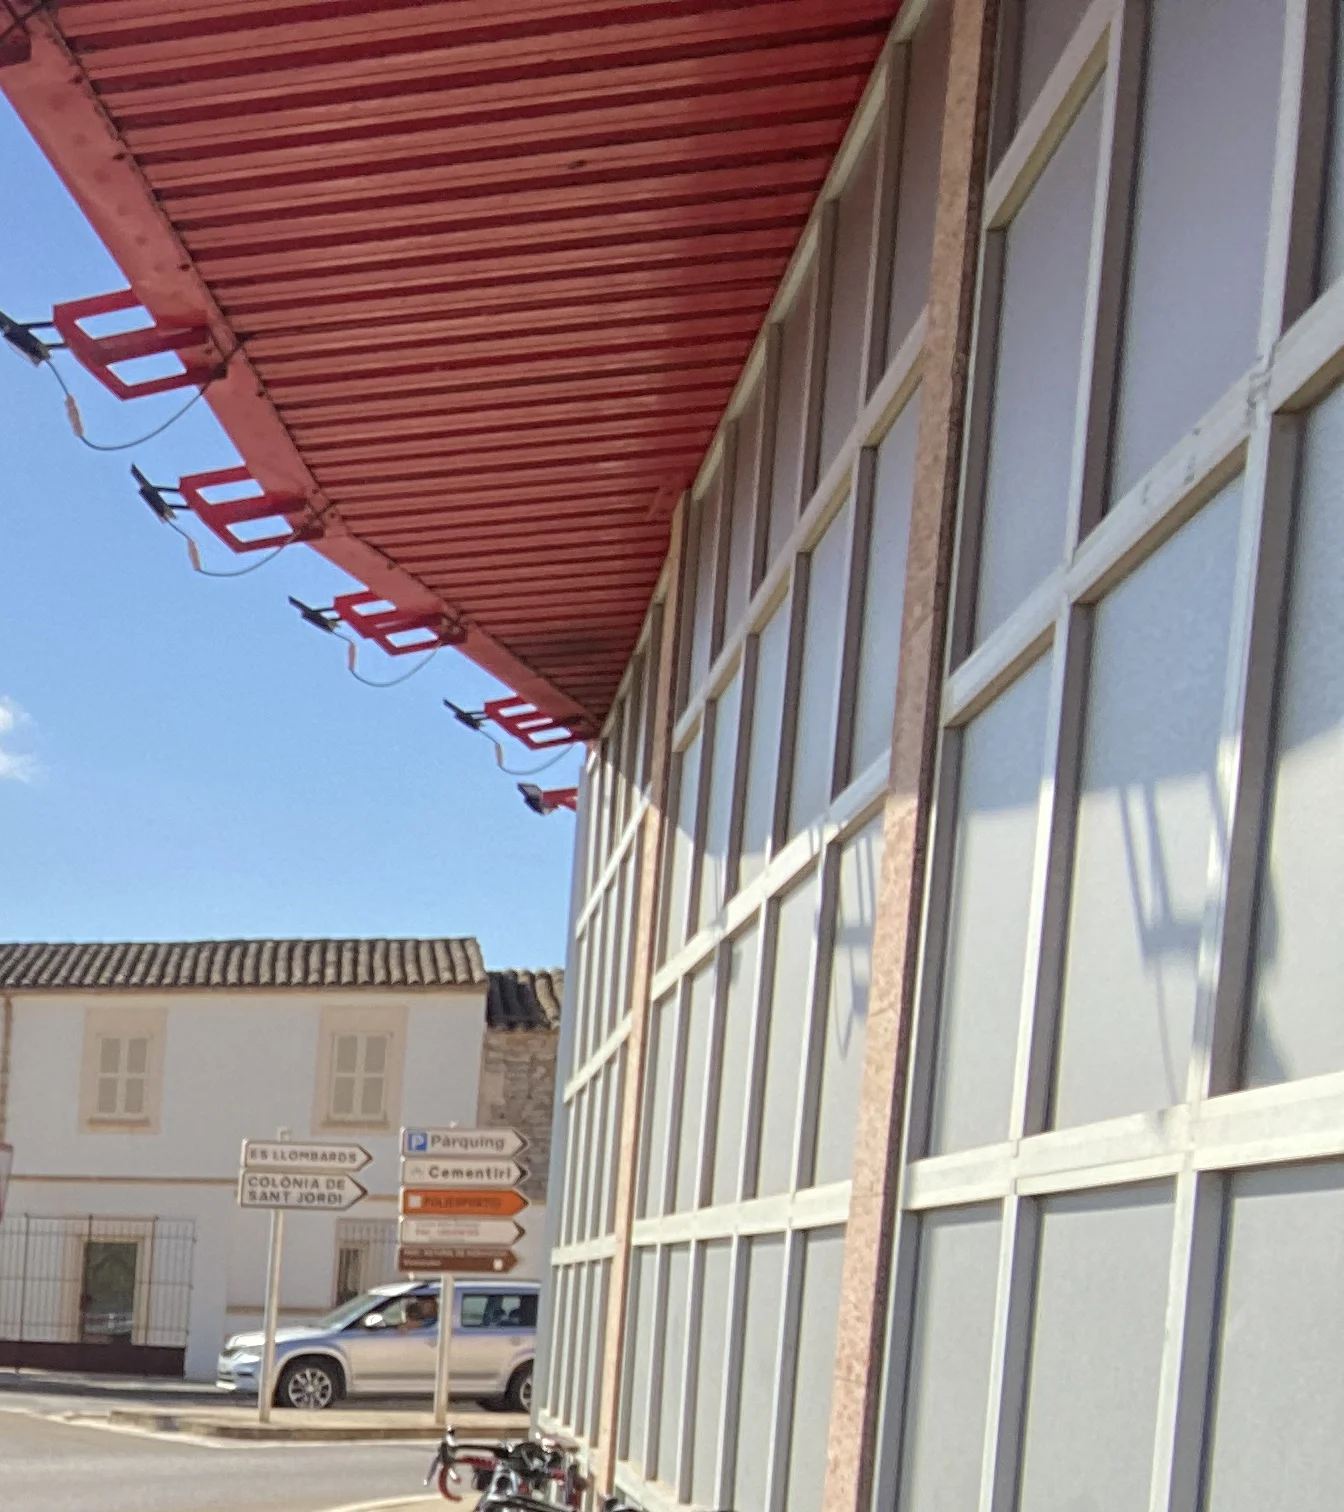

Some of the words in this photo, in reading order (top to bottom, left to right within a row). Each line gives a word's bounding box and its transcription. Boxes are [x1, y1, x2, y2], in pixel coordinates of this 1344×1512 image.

[250, 1148, 268, 1161] ES
[273, 1149, 357, 1163] LLOMBARDS
[428, 1164, 512, 1180] Cementiri
[326, 1178, 346, 1190] DE
[248, 1190, 290, 1203] SANT
[297, 1192, 342, 1205] JORDI
